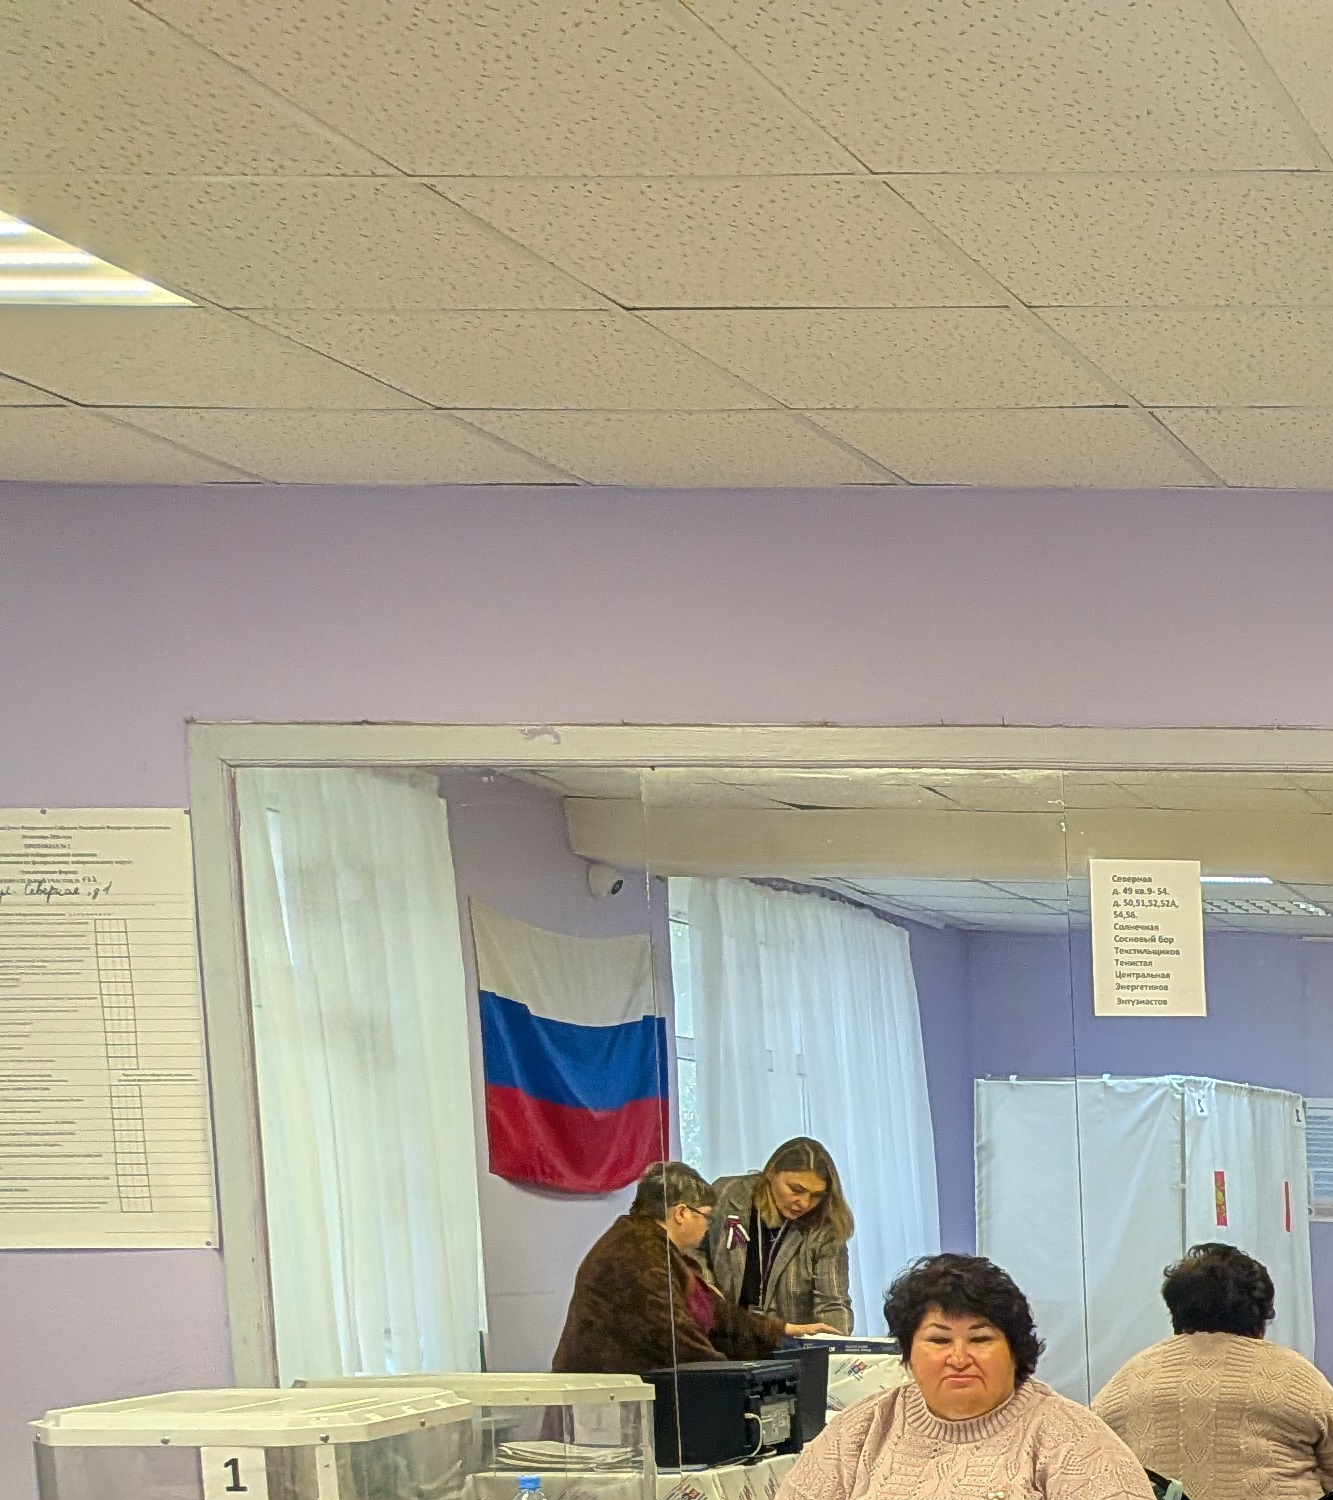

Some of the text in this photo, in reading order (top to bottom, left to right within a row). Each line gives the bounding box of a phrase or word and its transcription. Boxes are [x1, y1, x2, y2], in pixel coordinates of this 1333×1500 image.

[1112, 875, 1152, 884] Северная
[1123, 887, 1133, 895] 49
[1114, 923, 1159, 931] Солнечная
[1114, 935, 1157, 943] Сосновый
[1114, 947, 1180, 956] Текстильщиков
[1114, 959, 1153, 967] Тенистая
[1115, 971, 1171, 980] Центральная
[1116, 983, 1169, 992] Энергетиков
[1117, 997, 1168, 1006] Энтузиастов
[223, 1458, 248, 1492] 1
